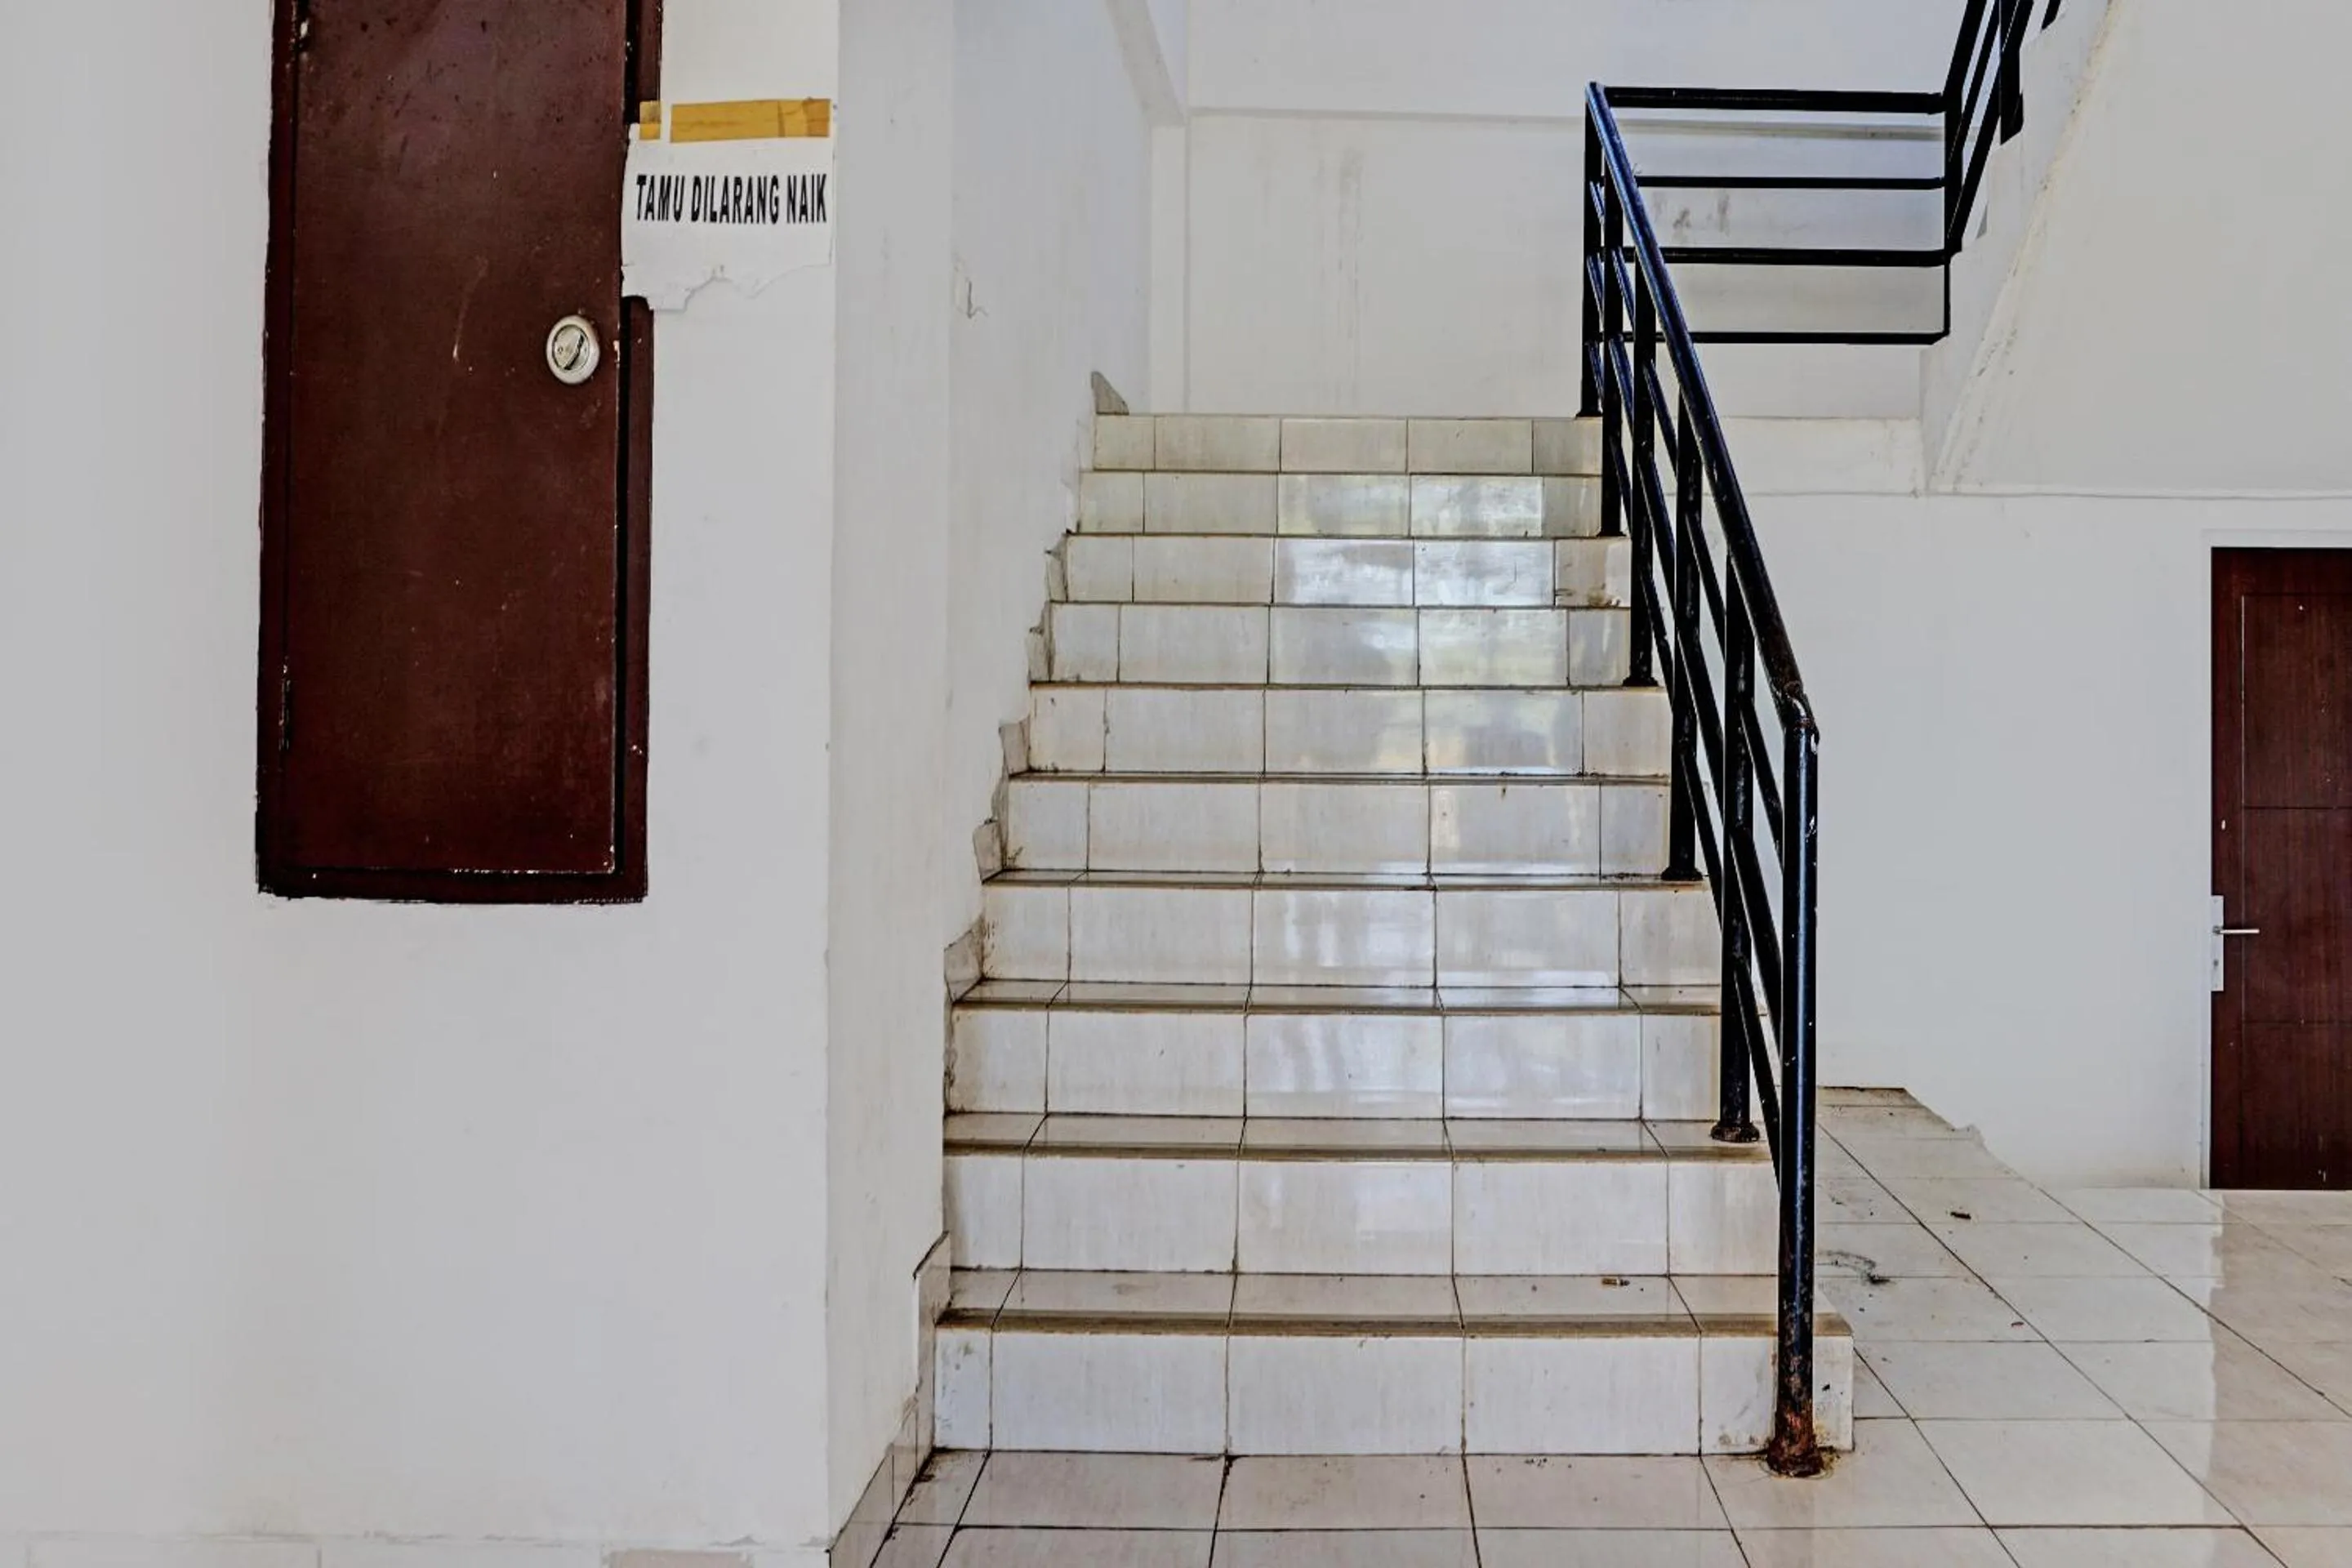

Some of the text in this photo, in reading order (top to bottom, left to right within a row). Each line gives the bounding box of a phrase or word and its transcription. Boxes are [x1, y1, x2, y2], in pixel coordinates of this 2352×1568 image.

[637, 174, 826, 224] TAMU DILARANG NAIK
